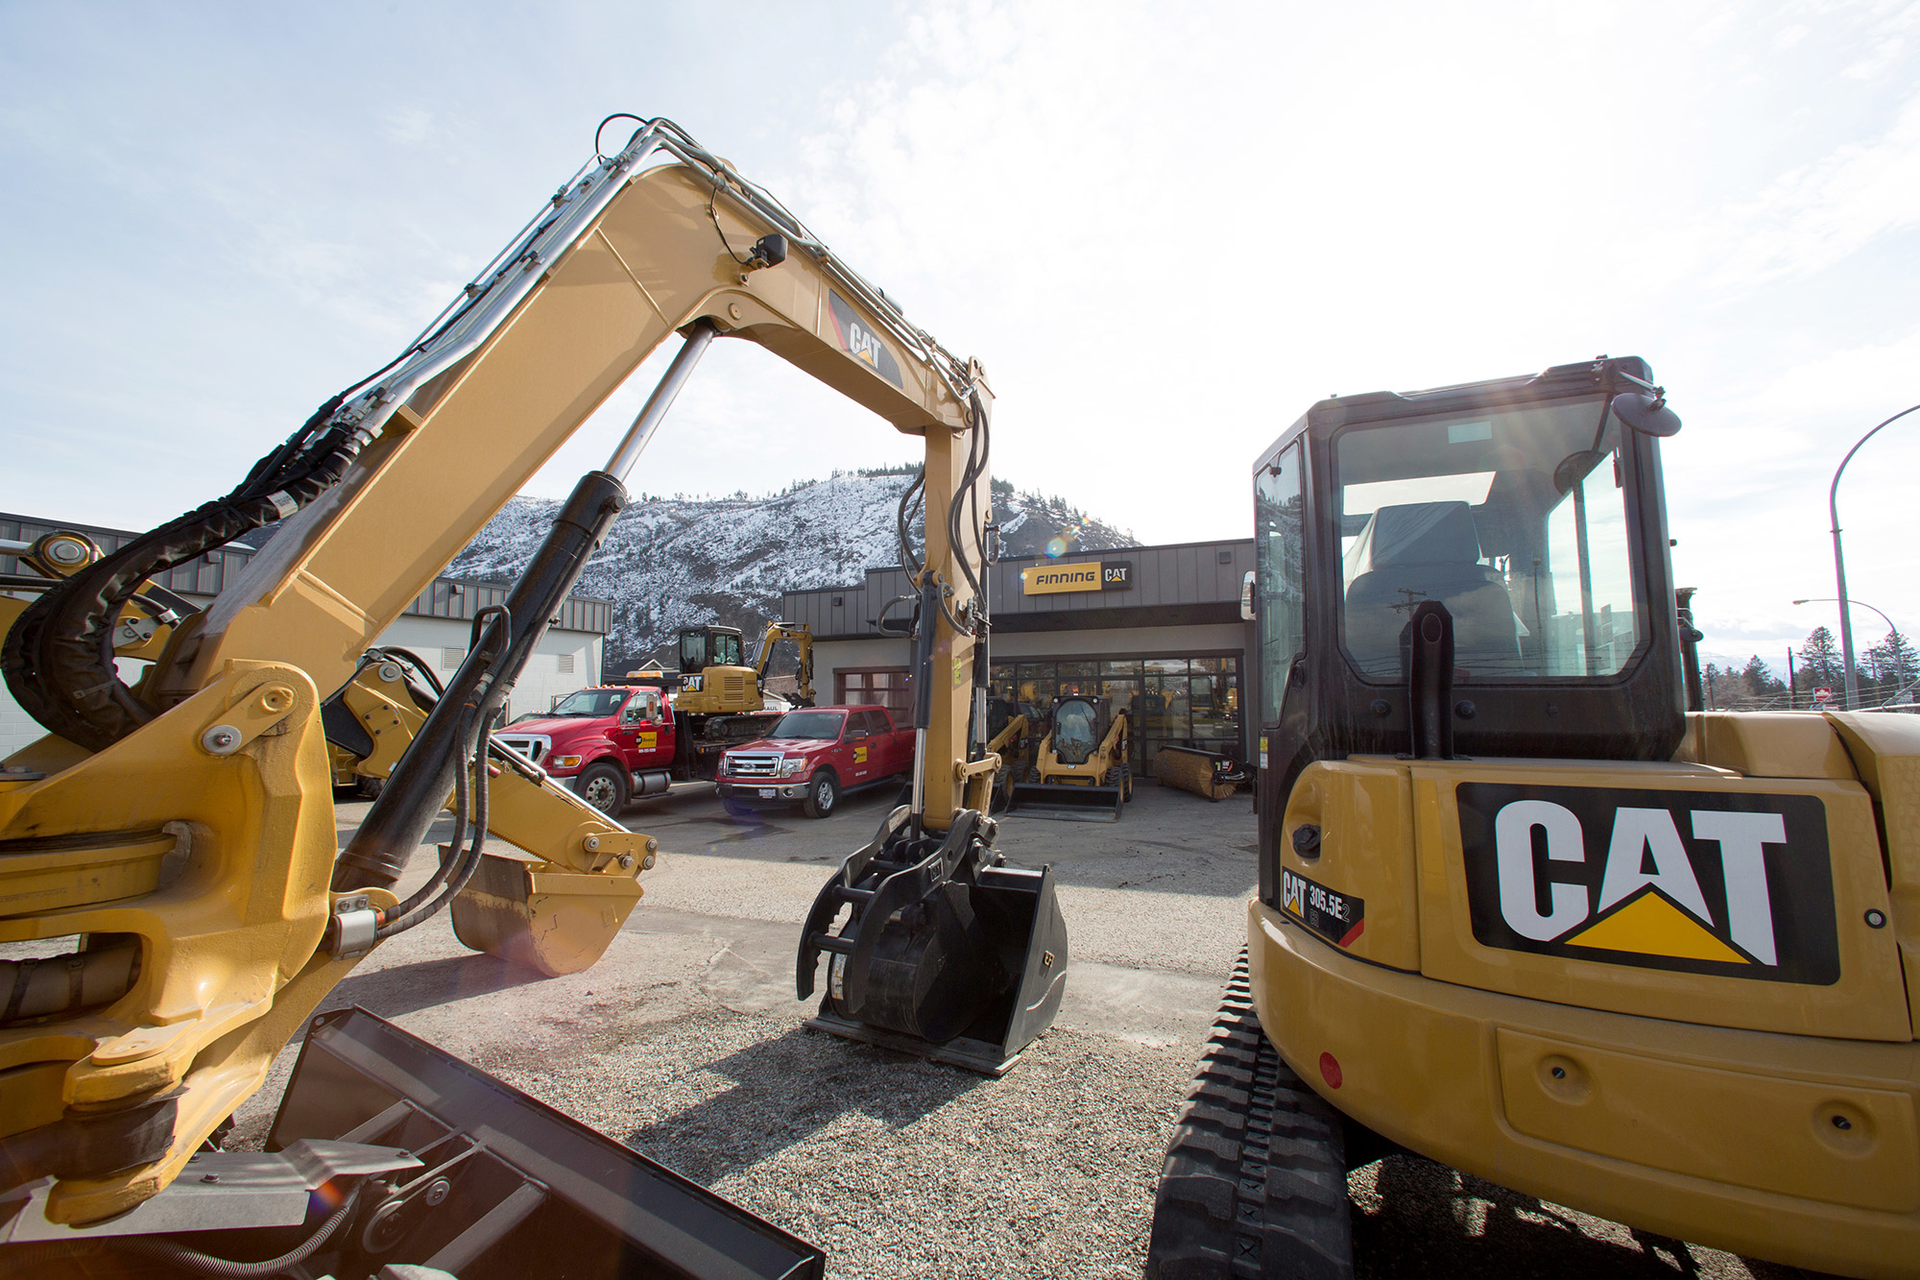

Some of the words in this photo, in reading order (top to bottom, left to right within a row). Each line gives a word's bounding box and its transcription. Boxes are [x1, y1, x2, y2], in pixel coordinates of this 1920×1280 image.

[850, 322, 881, 369] CAT
[1036, 572, 1095, 585] FINNING
[1105, 568, 1126, 581] CAT
[682, 676, 701, 691] CAT
[1283, 871, 1307, 919] CAT
[1495, 799, 1787, 966] CAT
